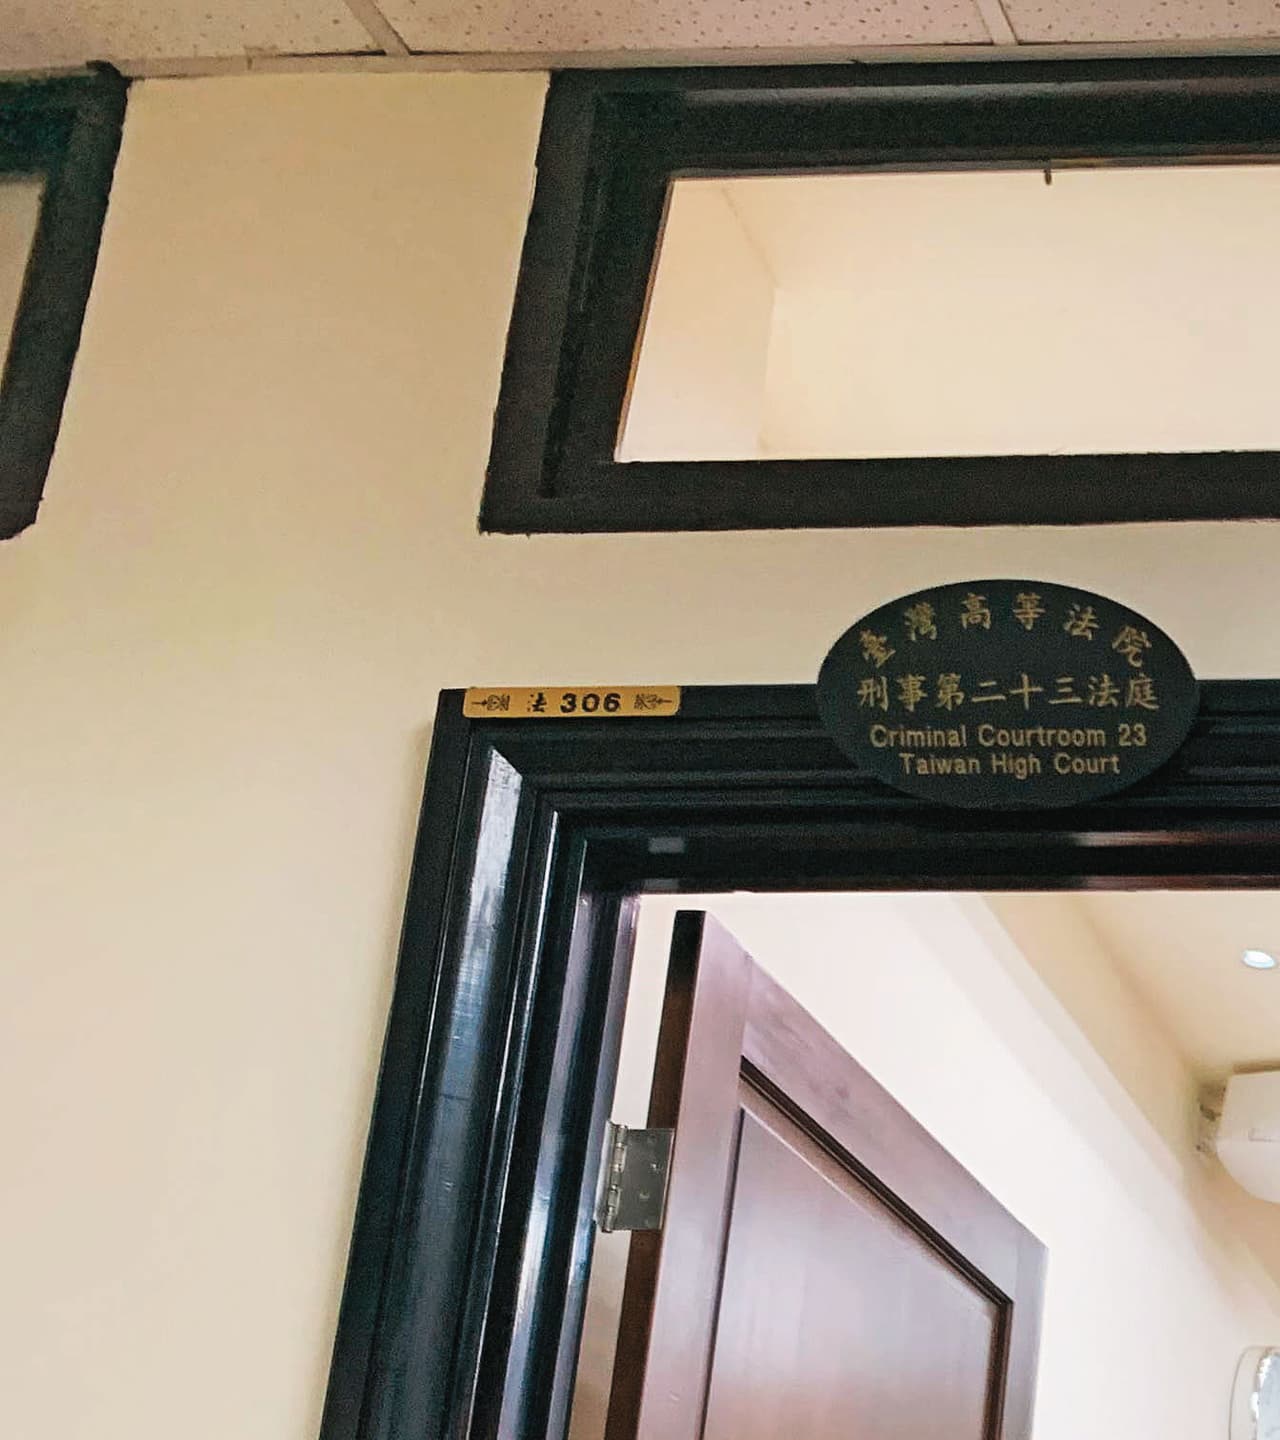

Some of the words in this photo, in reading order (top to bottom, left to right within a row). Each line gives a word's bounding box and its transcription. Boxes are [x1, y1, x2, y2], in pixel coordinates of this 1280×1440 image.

[859, 592, 1152, 668] 臺灣高等法院
[560, 692, 622, 713] 306
[856, 672, 1159, 712] 刑事第二十三法庭
[869, 725, 967, 747] Criminal
[977, 725, 1106, 747] Courtroom
[1118, 723, 1148, 747] 23
[899, 753, 981, 775] Taiwan
[991, 753, 1042, 780] High
[1054, 753, 1121, 775] Court
